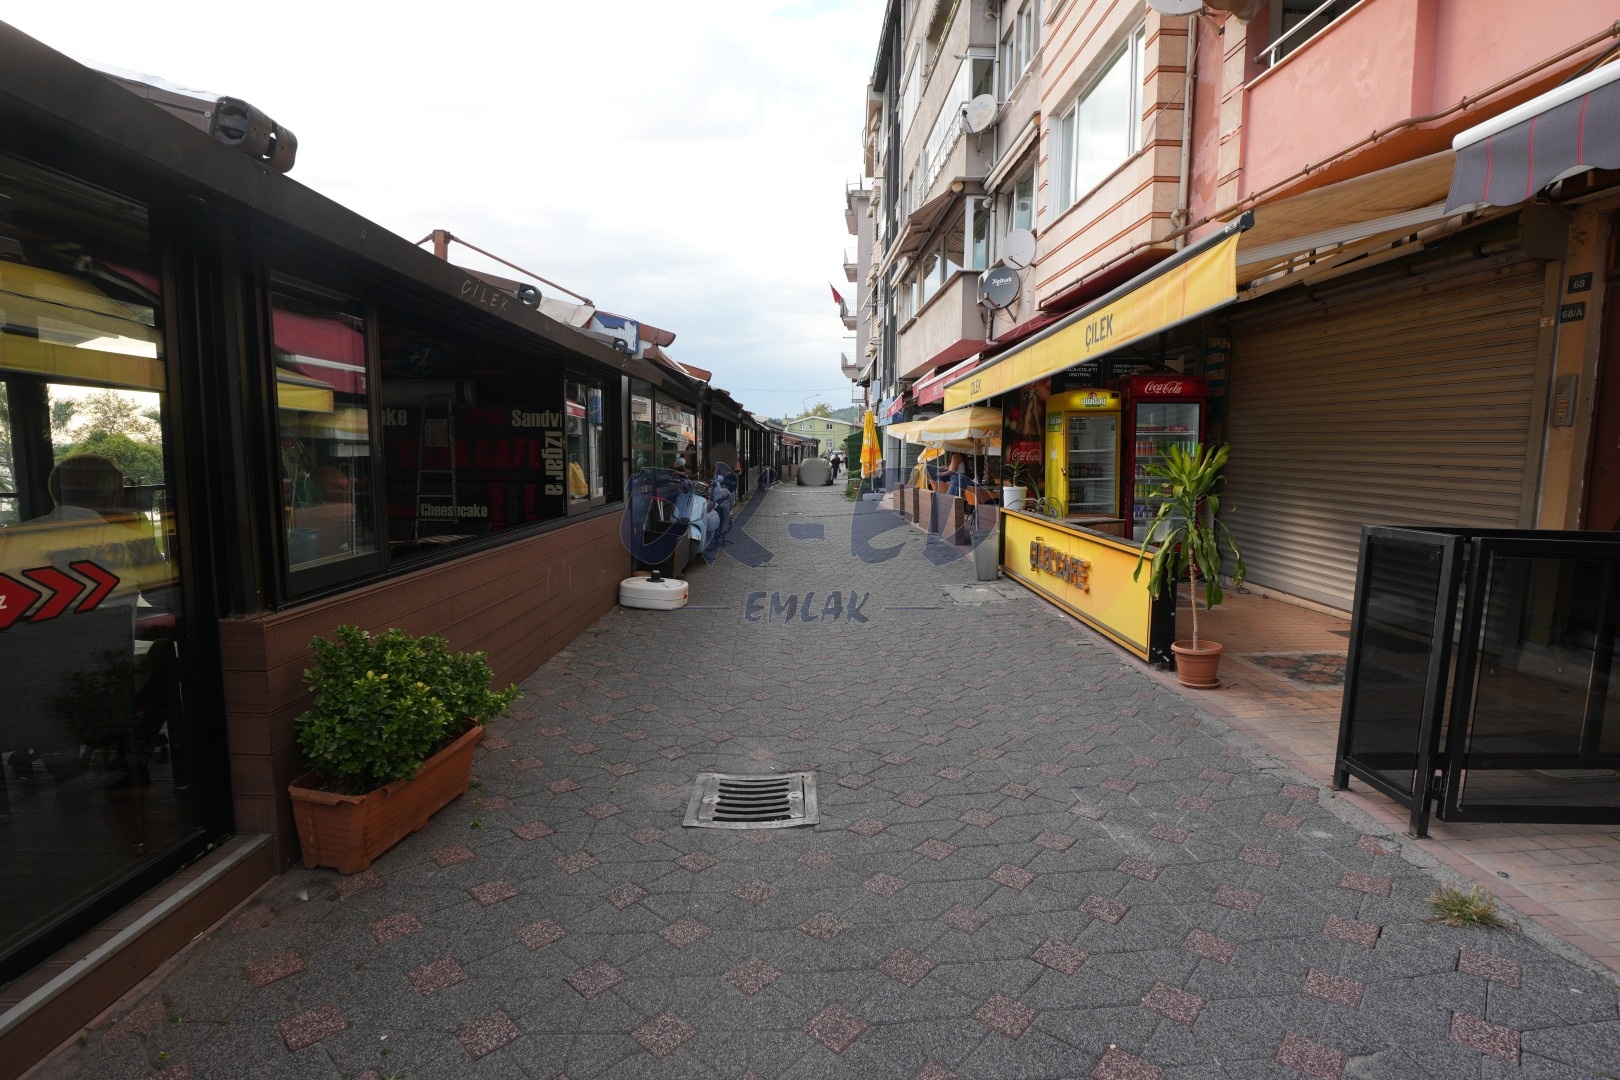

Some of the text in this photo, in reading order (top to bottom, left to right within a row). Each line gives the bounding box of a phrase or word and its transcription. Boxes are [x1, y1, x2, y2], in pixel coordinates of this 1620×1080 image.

[1573, 279, 1585, 289] 68
[1562, 308, 1583, 319] 68/A
[1085, 313, 1114, 353] ÇİLEK
